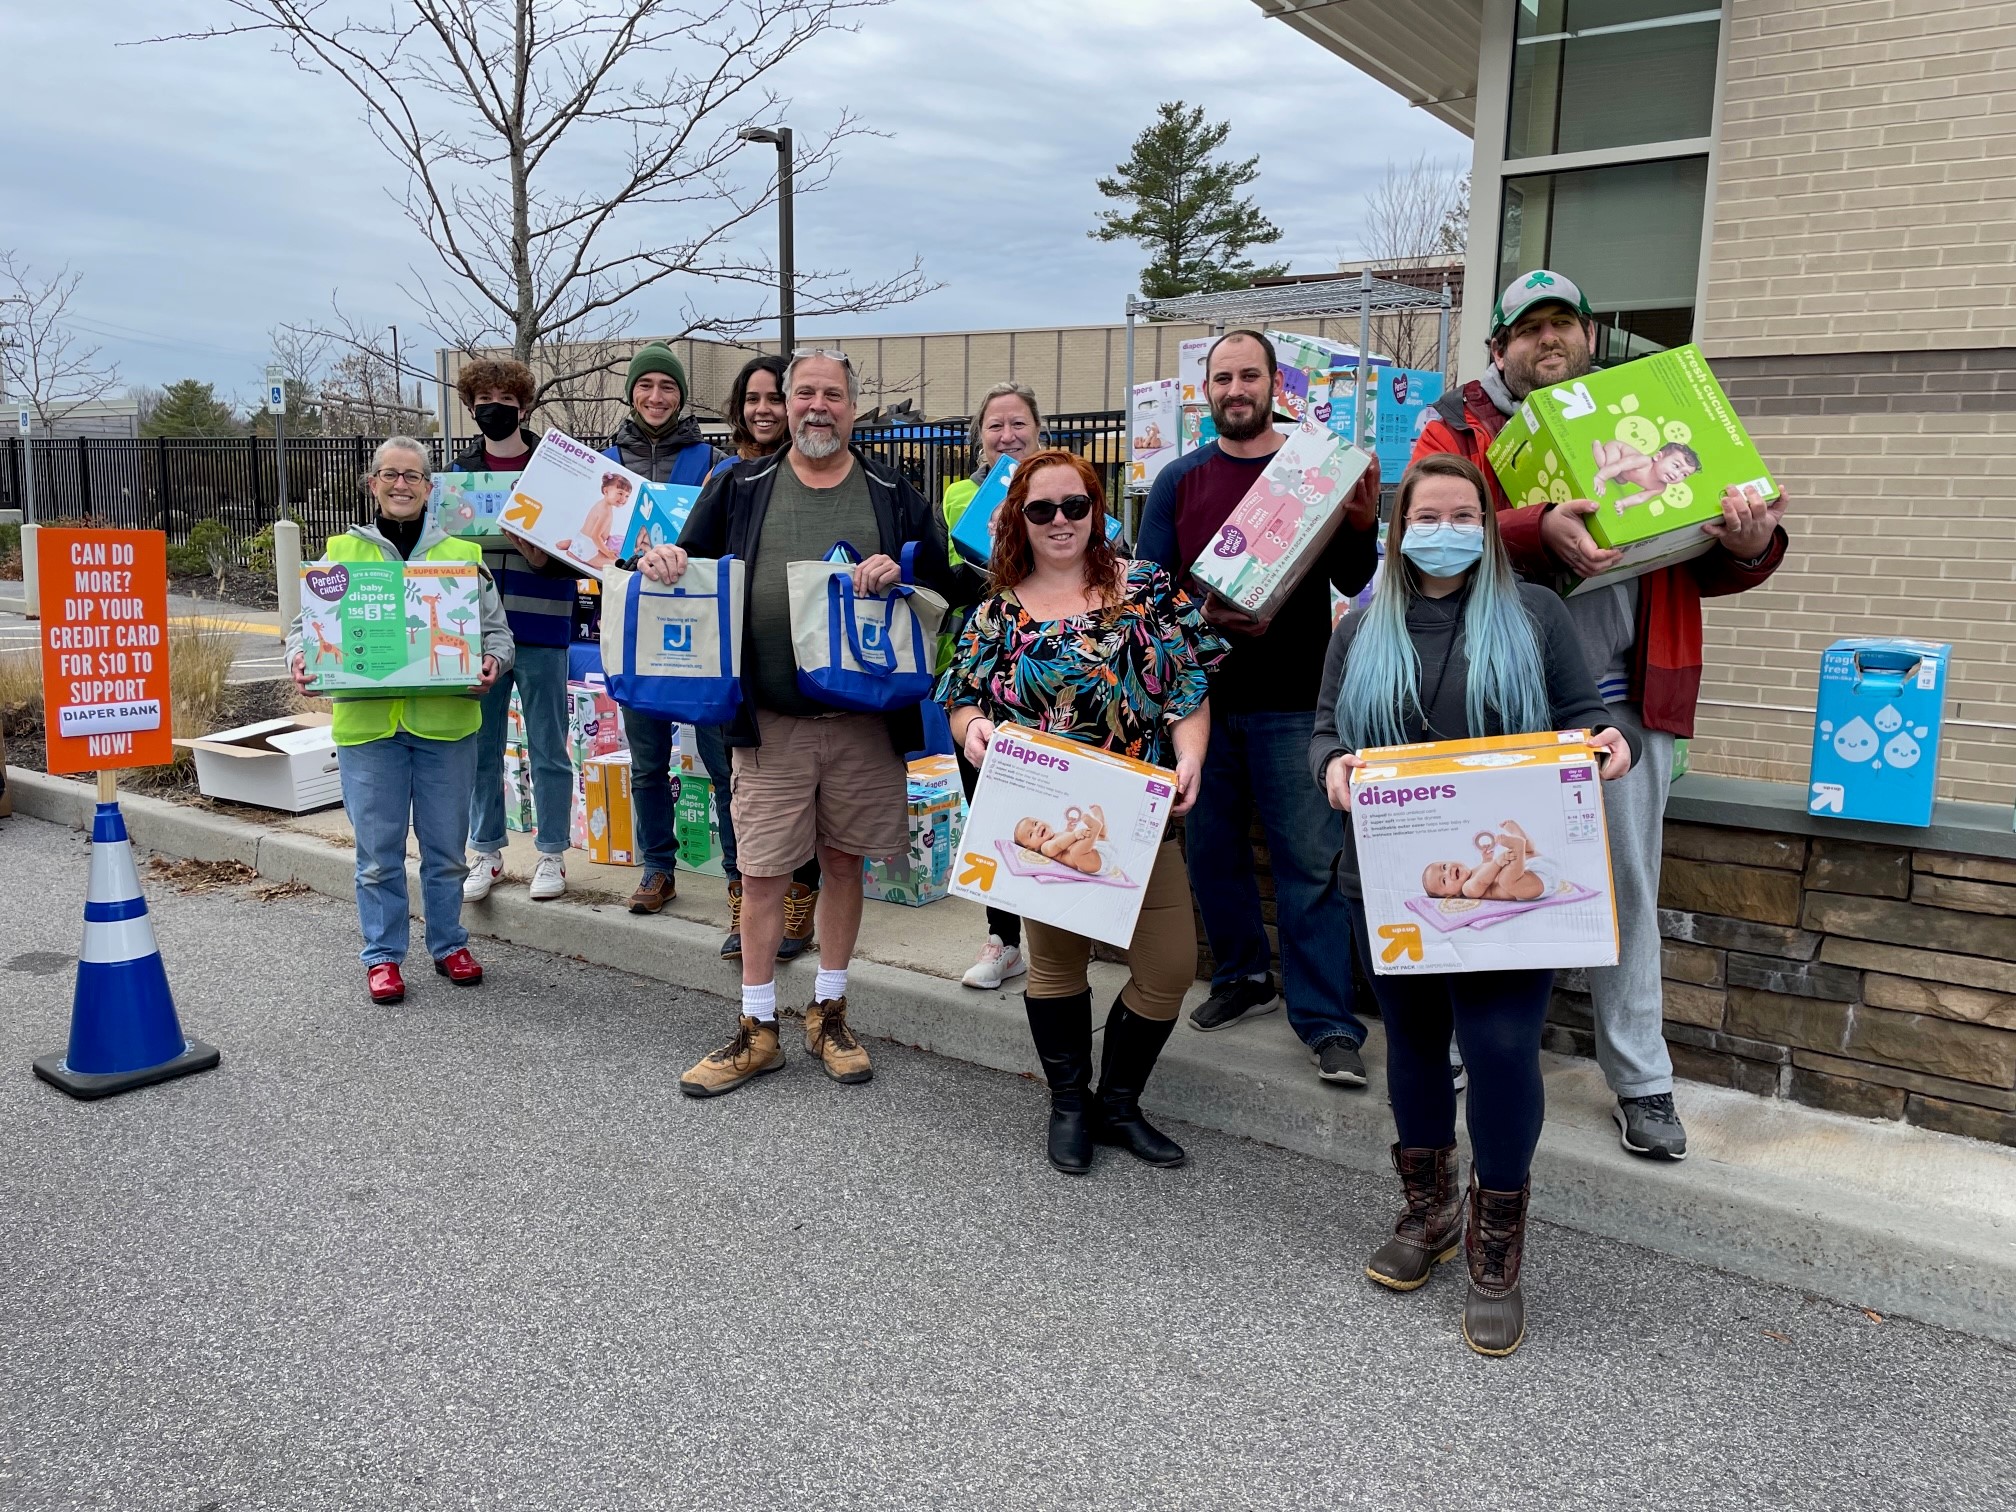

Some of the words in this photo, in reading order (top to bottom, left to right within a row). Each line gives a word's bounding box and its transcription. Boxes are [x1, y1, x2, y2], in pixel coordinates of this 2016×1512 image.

[1133, 386, 1152, 396] apers
[1684, 350, 1707, 382] fresh
[1704, 385, 1744, 446] cucumber
[1702, 401, 1716, 421] wipes
[548, 433, 596, 464] diapers
[1248, 508, 1263, 524] fresh
[1254, 510, 1269, 528] scent
[1219, 529, 1237, 554] Parent's
[71, 543, 105, 565] CAN
[112, 544, 133, 565] DO
[75, 571, 131, 593] MORE?
[312, 571, 347, 588] Parent's
[360, 584, 383, 592] baby
[320, 584, 344, 595] CHOICE
[348, 592, 395, 602] diapers
[1245, 586, 1264, 608] 800
[65, 599, 93, 621] DIP
[99, 599, 143, 620] YOUR
[348, 608, 364, 616] 156
[51, 626, 110, 649] CREDIT
[116, 625, 160, 647] CARD
[61, 654, 92, 677] FOR
[99, 652, 127, 678] $10
[132, 652, 152, 673] TO
[1824, 664, 1848, 674] free
[70, 679, 146, 703] SUPPORT
[63, 708, 115, 721] DIAPER
[120, 705, 158, 716] BANK
[89, 733, 133, 757] NOW!
[994, 739, 1070, 772] diapers
[680, 798, 704, 808] diapers
[1358, 784, 1456, 807] diapers
[1574, 791, 1582, 804] 1
[1150, 802, 1156, 812] 1
[689, 813, 695, 821] 5
